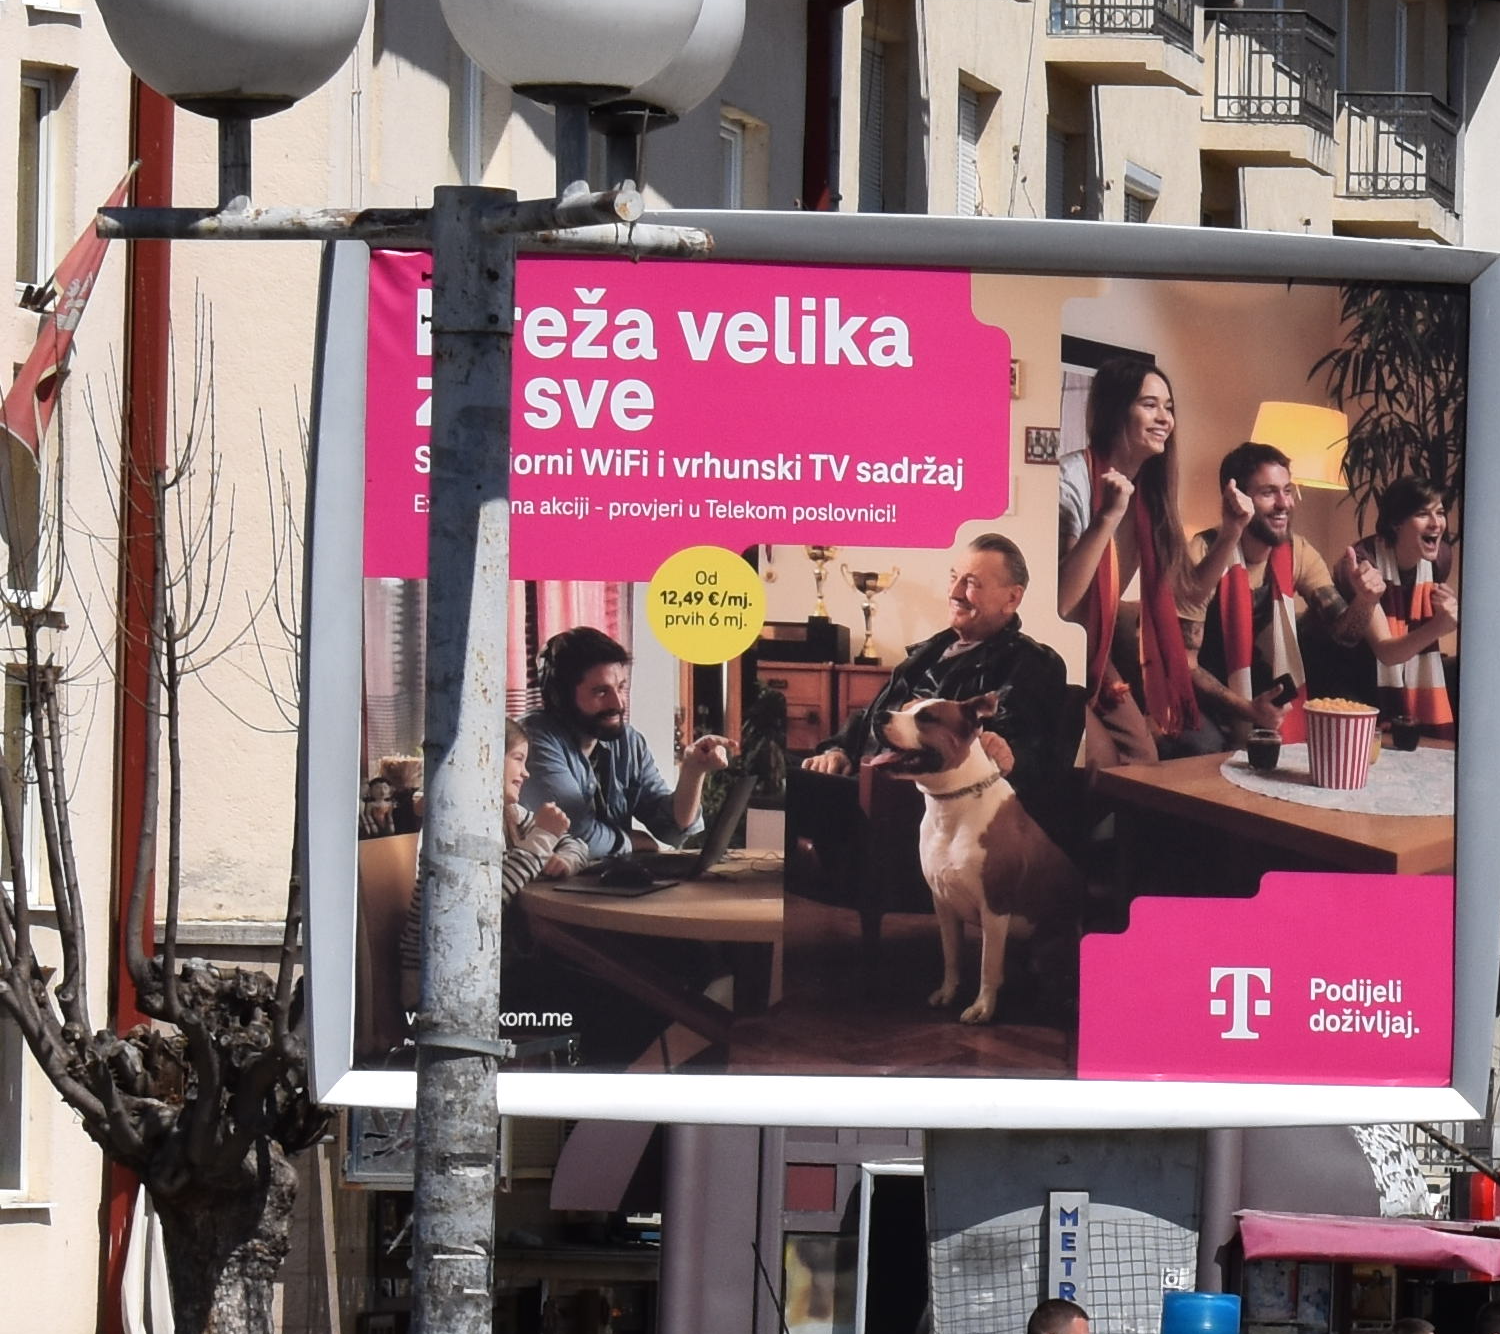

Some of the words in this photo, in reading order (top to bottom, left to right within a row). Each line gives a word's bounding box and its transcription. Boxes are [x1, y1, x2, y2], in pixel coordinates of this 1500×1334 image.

[416, 287, 658, 361] eža
[678, 297, 914, 368] velika
[523, 378, 656, 432] sve
[415, 445, 574, 478] Siorni
[581, 448, 649, 478] WiFi
[657, 450, 665, 478] i
[672, 450, 802, 482] vrhunski
[808, 454, 851, 483] TV
[856, 455, 964, 492] sadržaj
[540, 497, 590, 518] akciji
[608, 498, 683, 522] provjeri
[689, 504, 701, 519] u
[705, 499, 787, 521] Telekom
[791, 500, 897, 527] poslovnici!
[695, 570, 718, 586] Od
[660, 590, 704, 608] 12,49
[708, 590, 753, 610] €/mj.
[664, 613, 705, 629] prvih
[709, 612, 720, 627] 6
[723, 614, 748, 630] mj.
[1309, 977, 1403, 1008] Podijeli
[1309, 1007, 1421, 1040] doživljaj.
[1058, 1206, 1080, 1302] METR
